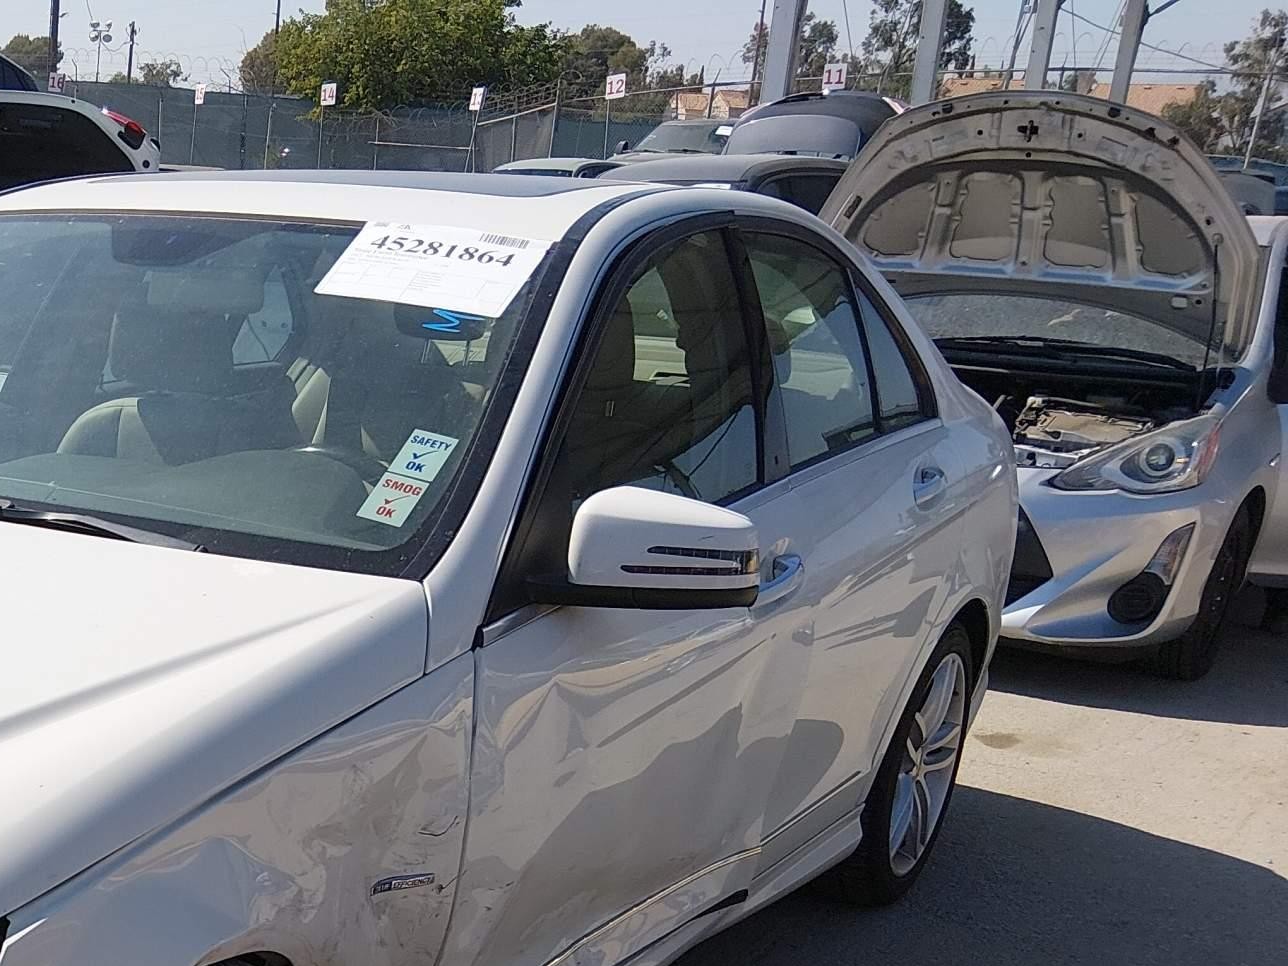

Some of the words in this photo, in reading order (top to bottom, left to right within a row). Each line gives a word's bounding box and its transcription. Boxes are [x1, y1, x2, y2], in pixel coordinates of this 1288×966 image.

[823, 68, 844, 85] 11
[322, 87, 335, 102] 14
[607, 79, 625, 95] 12
[370, 234, 516, 268] 45281864
[410, 435, 452, 451] SAFETY
[405, 461, 427, 473] OK
[382, 478, 423, 496] SMOG
[375, 505, 397, 518] OK
